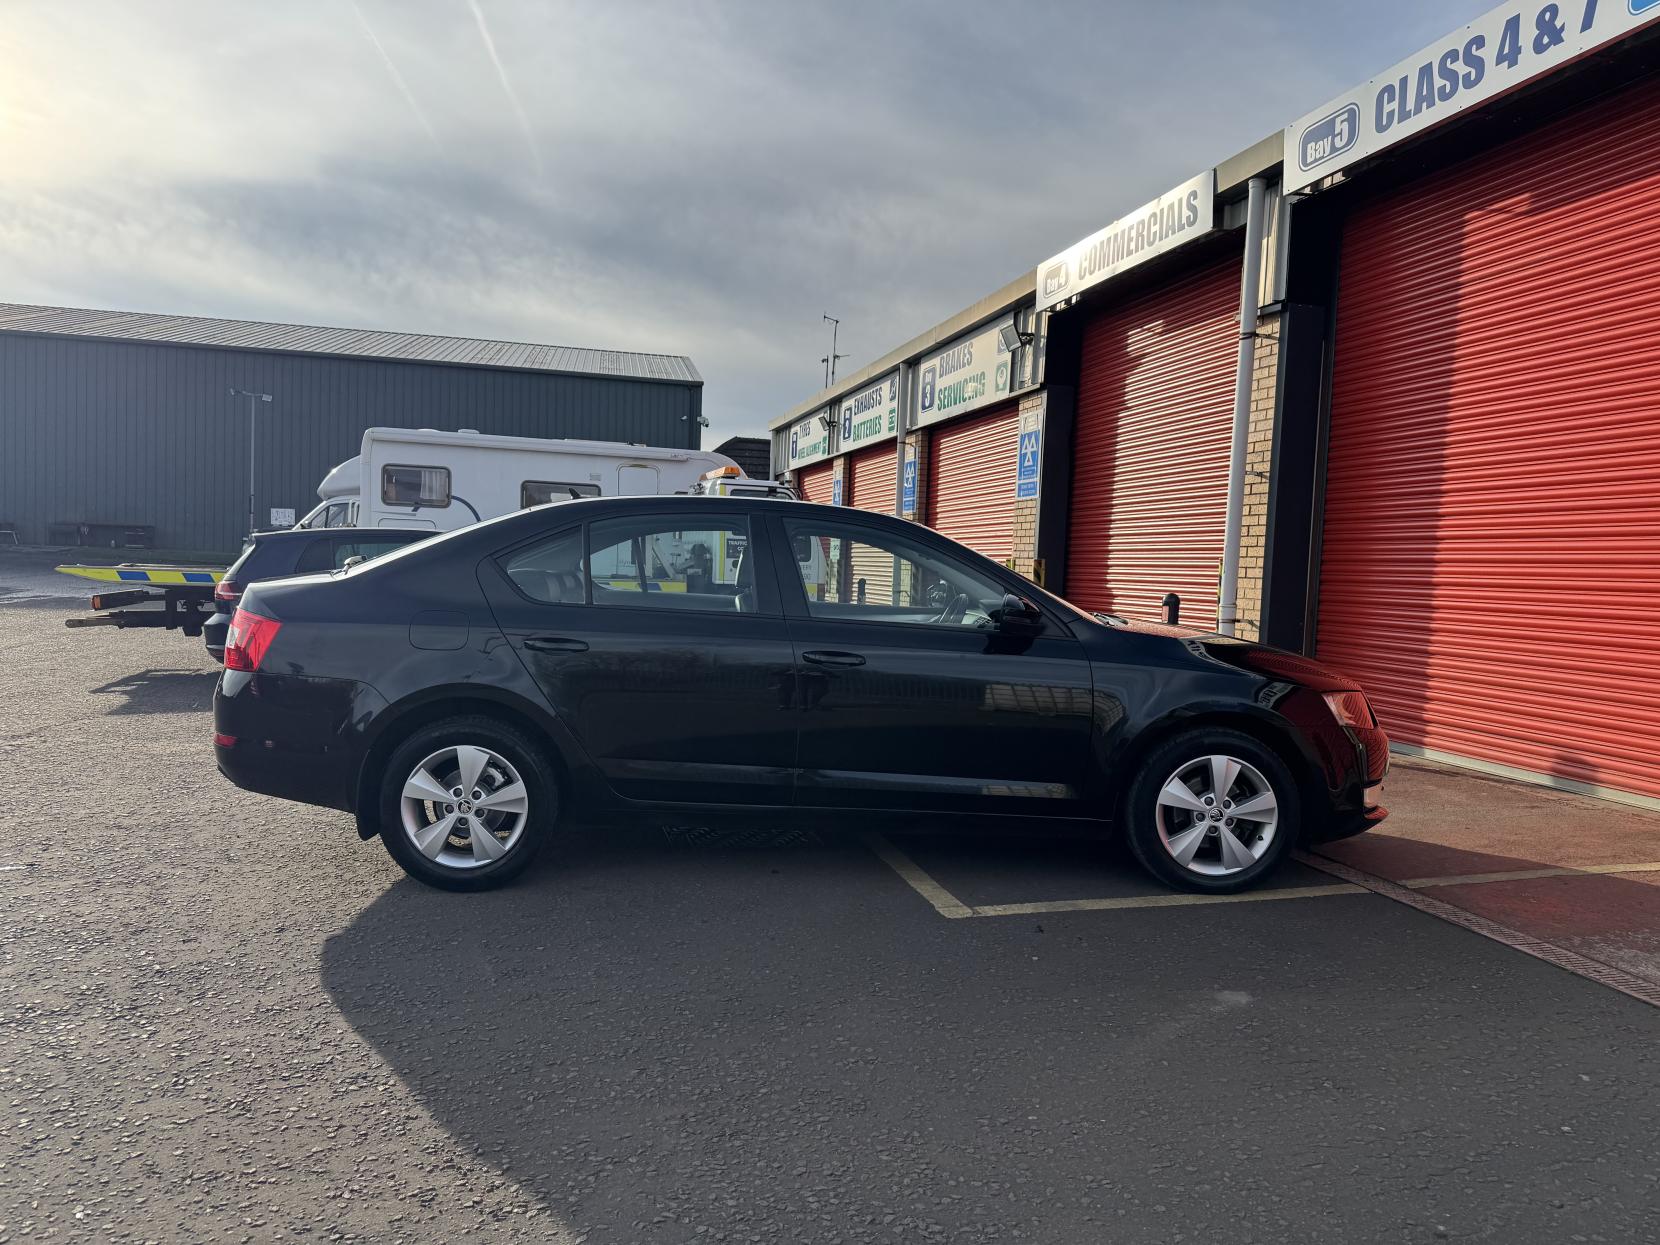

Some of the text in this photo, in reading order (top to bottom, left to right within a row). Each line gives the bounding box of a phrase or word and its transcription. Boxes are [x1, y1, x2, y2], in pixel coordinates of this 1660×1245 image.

[1374, 34, 1486, 134] CLASS
[1495, 12, 1522, 70] 4
[1532, 3, 1565, 55] &
[1306, 112, 1349, 163] Bay 5
[1078, 189, 1199, 281] COMMERCIALS
[938, 341, 974, 379] BRAKES
[854, 386, 883, 416] EXHAUSTS
[852, 414, 882, 442] BATTERIES
